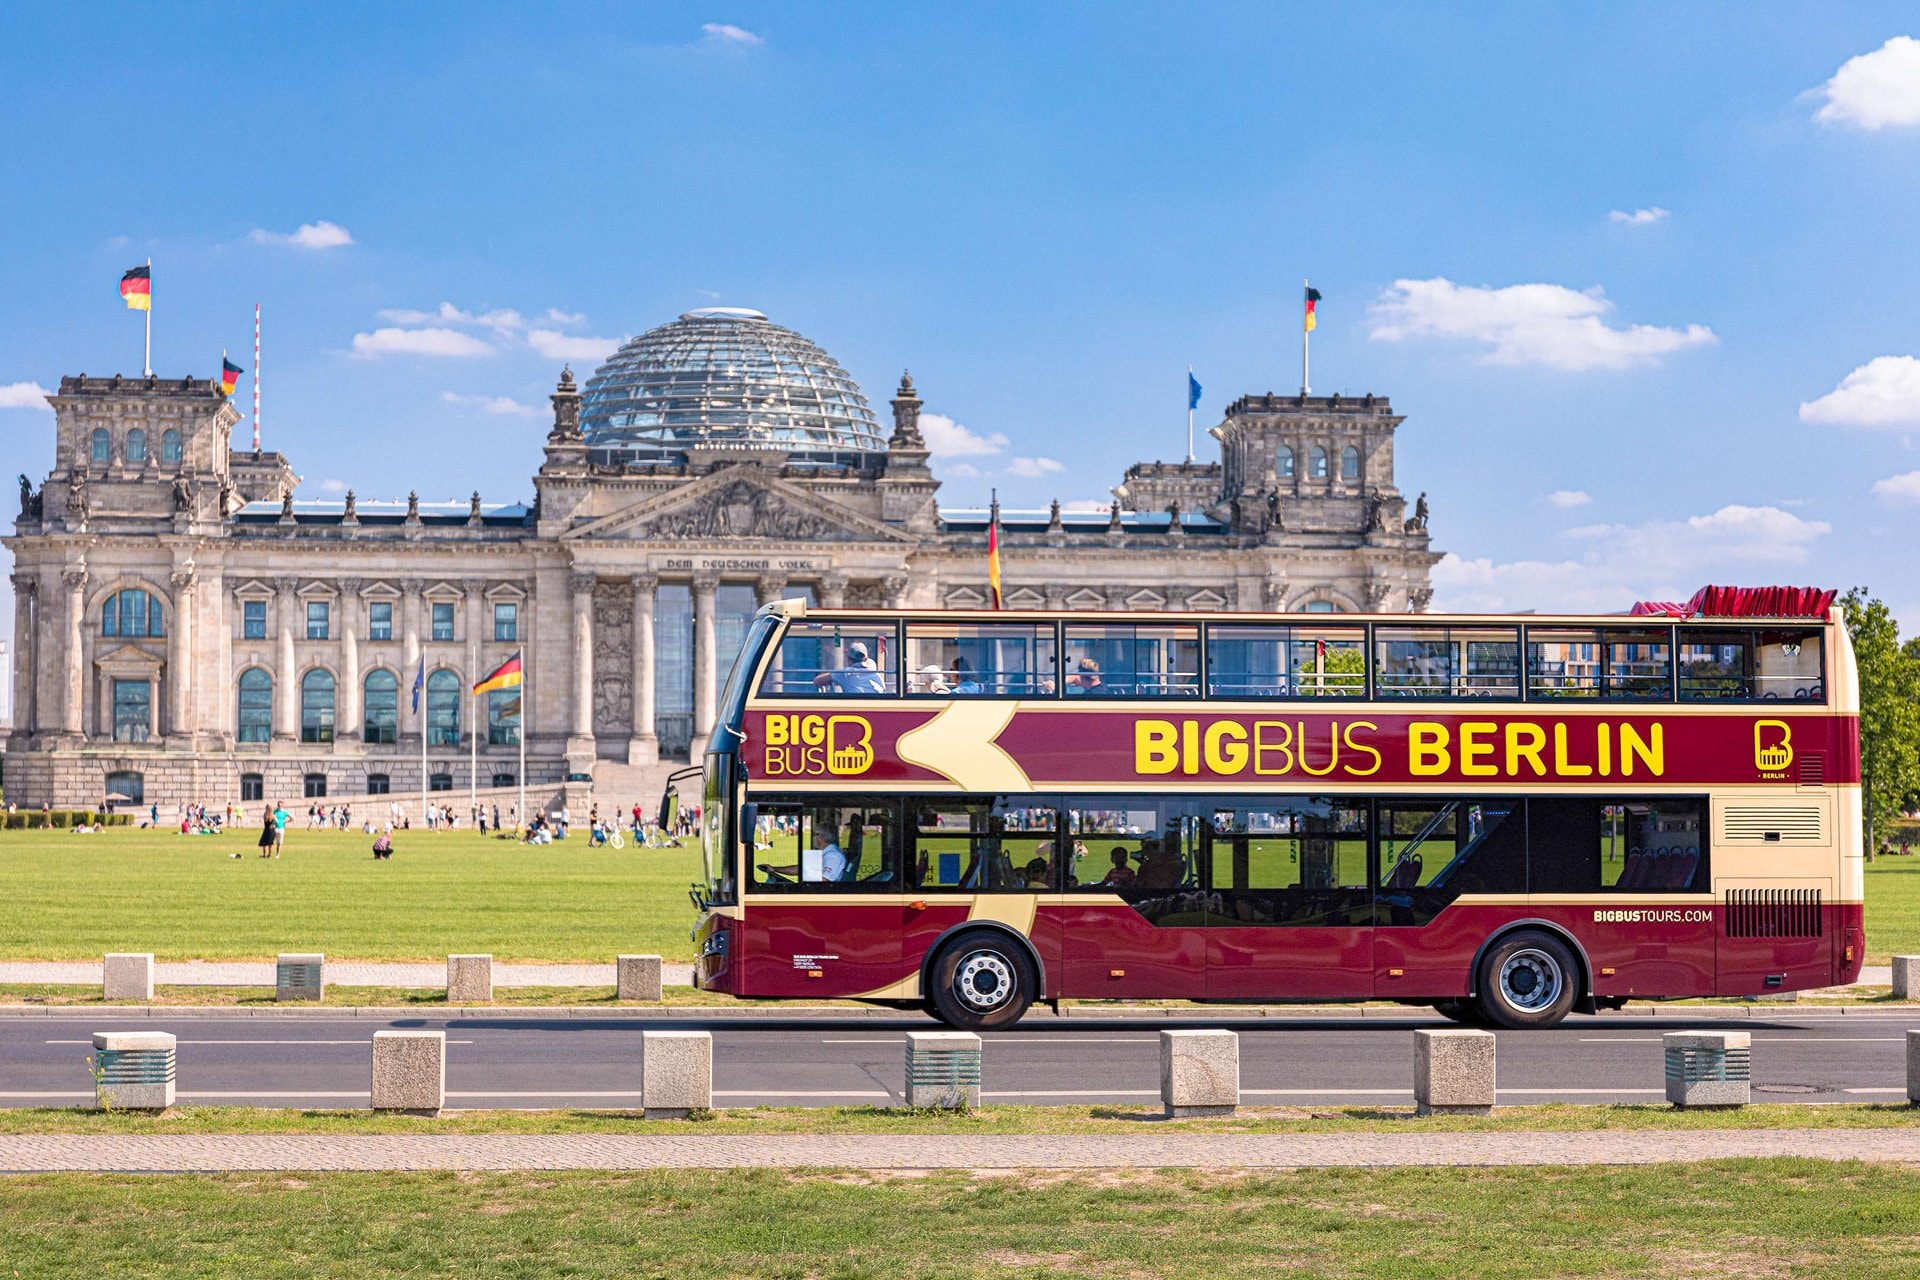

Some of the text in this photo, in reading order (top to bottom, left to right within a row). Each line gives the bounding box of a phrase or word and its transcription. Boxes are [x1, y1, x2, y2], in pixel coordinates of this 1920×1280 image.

[667, 559, 813, 569] DEM DEUTSCHEN VOLKE
[765, 714, 826, 746] BIG
[765, 746, 826, 775] BUS
[1408, 722, 1664, 777] BERLIN
[1593, 910, 1713, 923] BIGBUSTOURS.COM
